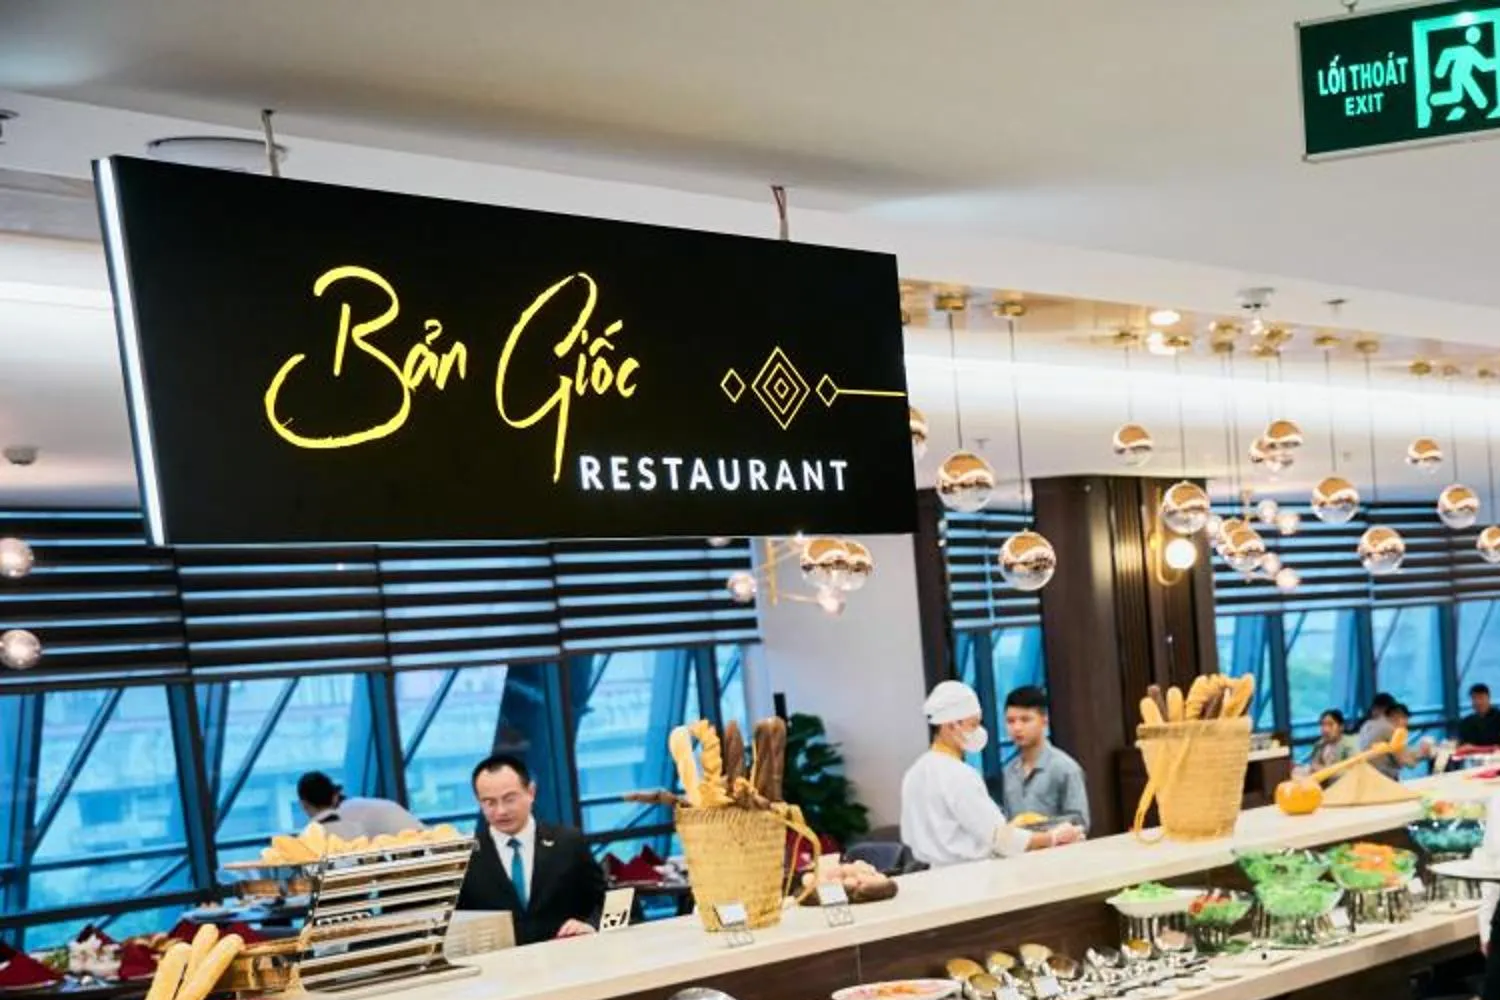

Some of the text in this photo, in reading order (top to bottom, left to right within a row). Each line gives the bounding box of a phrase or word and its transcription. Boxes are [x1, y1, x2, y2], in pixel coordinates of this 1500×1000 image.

[1317, 51, 1409, 96] LỐI THOÁT
[1344, 92, 1385, 117] EXIT
[263, 264, 640, 482] Bản Giốc
[579, 454, 849, 492] RESTAURANT
